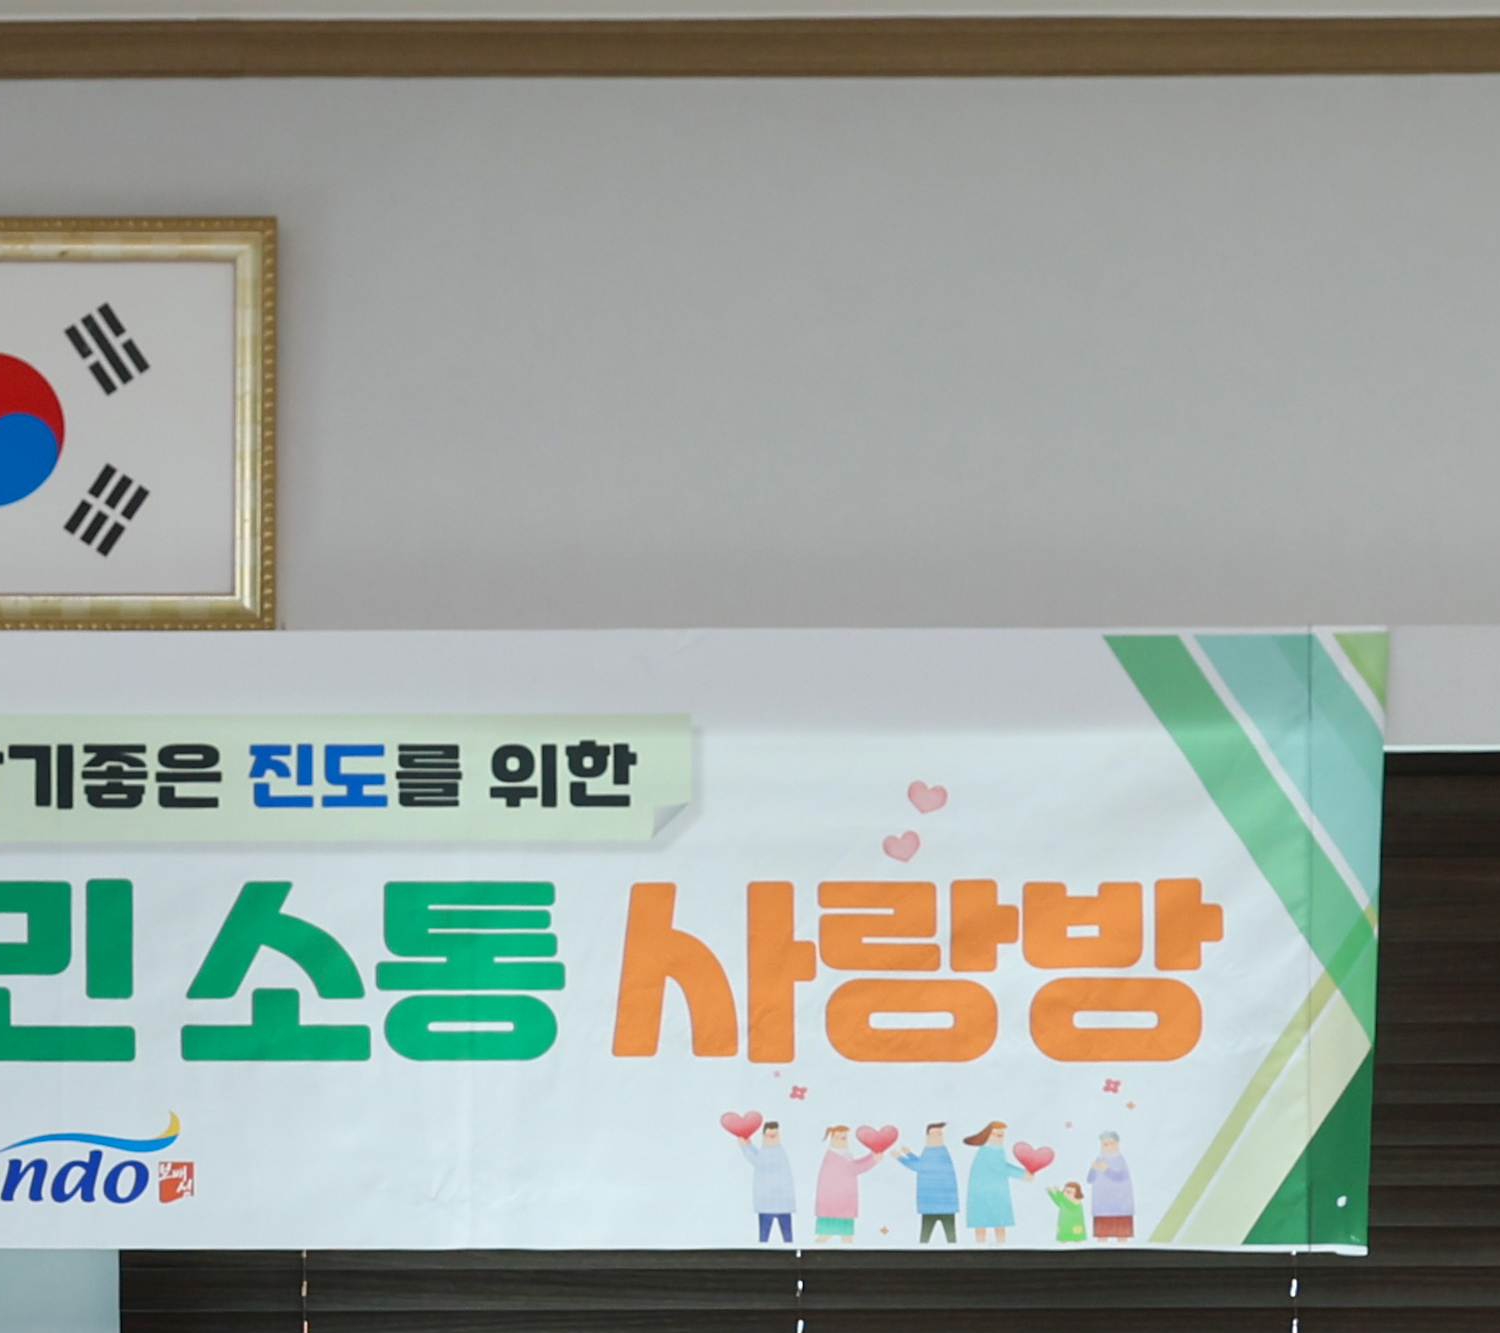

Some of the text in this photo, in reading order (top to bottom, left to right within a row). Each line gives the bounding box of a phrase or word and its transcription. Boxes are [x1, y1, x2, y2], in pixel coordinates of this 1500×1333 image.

[249, 744, 465, 810] 진도를
[489, 741, 639, 810] 위한
[182, 881, 568, 1063] 소통
[612, 878, 1226, 1066] 사랑방
